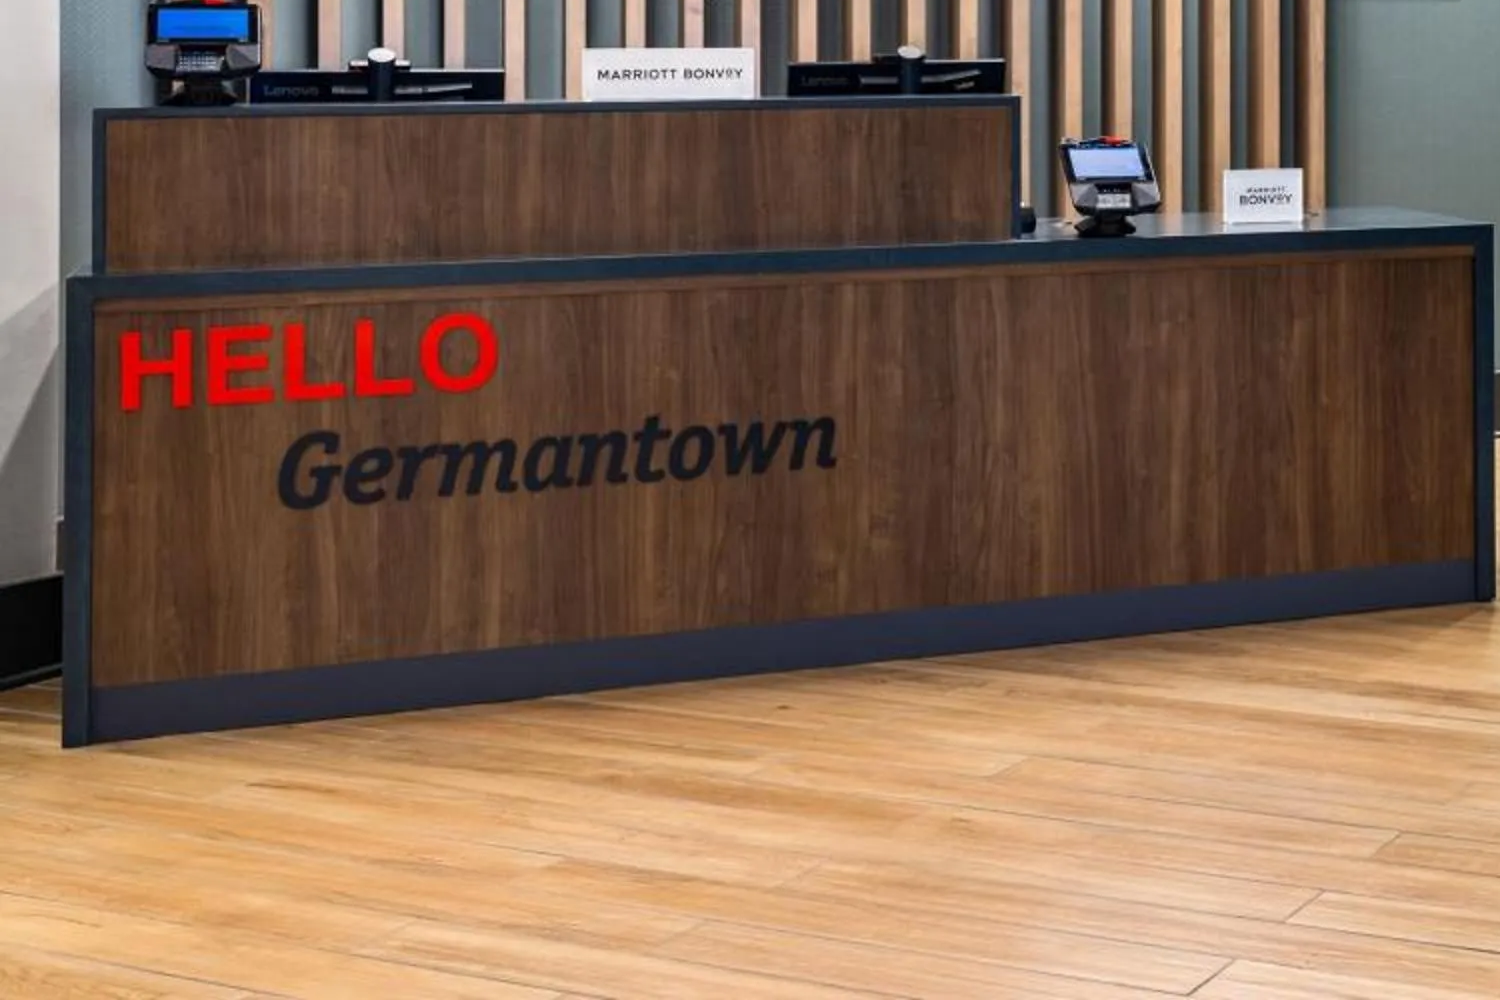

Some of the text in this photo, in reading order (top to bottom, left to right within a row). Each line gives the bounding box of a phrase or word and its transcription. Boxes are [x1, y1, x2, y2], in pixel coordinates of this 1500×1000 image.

[597, 67, 743, 81] MARRIOTT BONVOY
[263, 84, 320, 97] Lenovo
[1239, 193, 1293, 206] BONVOY
[119, 312, 499, 411] HELLO
[277, 414, 838, 510] Germantown
